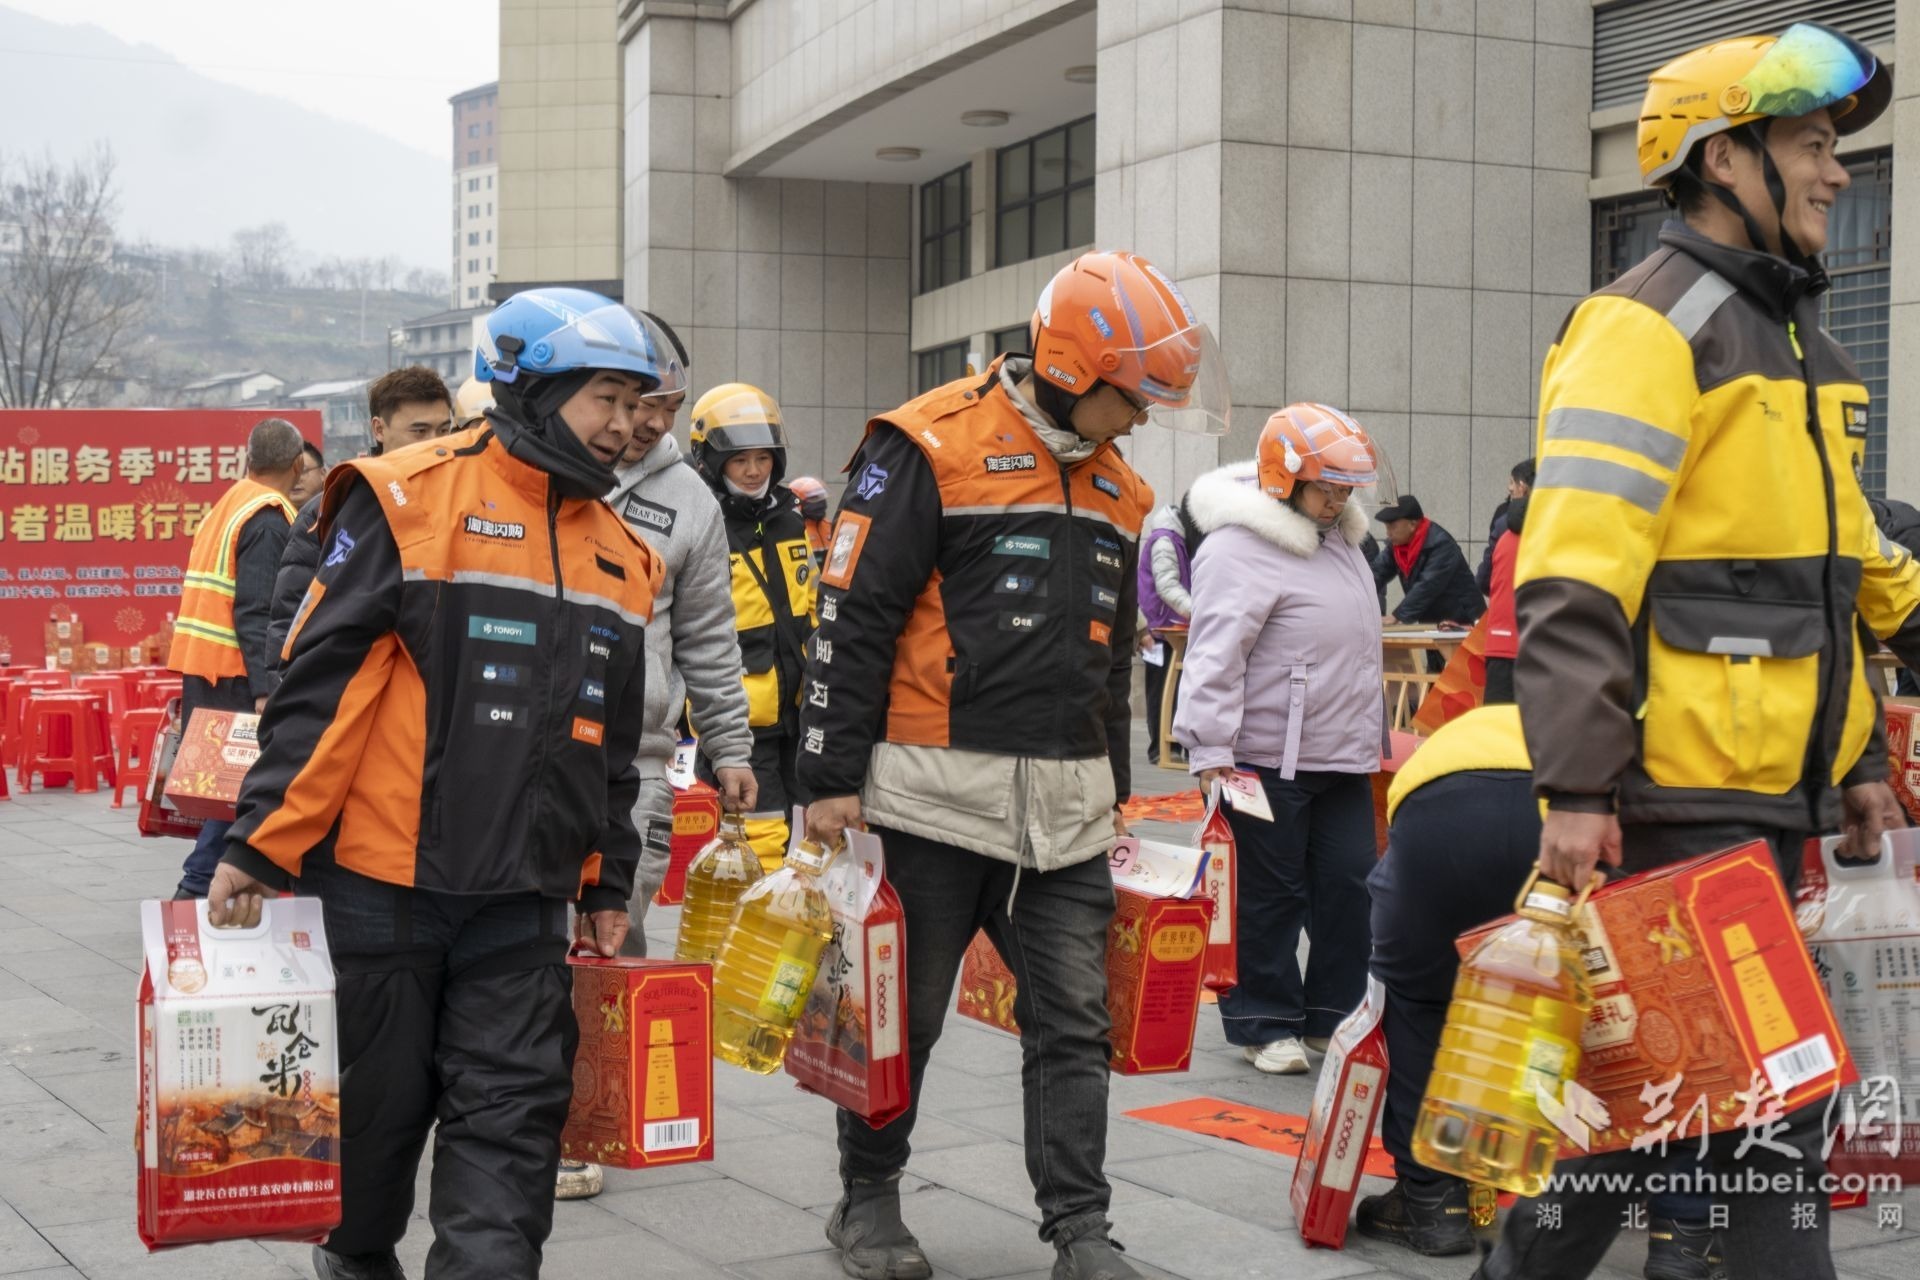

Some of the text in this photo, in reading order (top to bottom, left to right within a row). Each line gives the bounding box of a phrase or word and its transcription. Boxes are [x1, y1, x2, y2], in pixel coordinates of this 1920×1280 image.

[986, 454, 1036, 472] 淘宝闪购
[627, 503, 670, 526] SHAN YES
[466, 516, 524, 539] 淘宝闪购
[493, 626, 523, 636] TONGYI
[804, 594, 838, 755] 淘宝闪购
